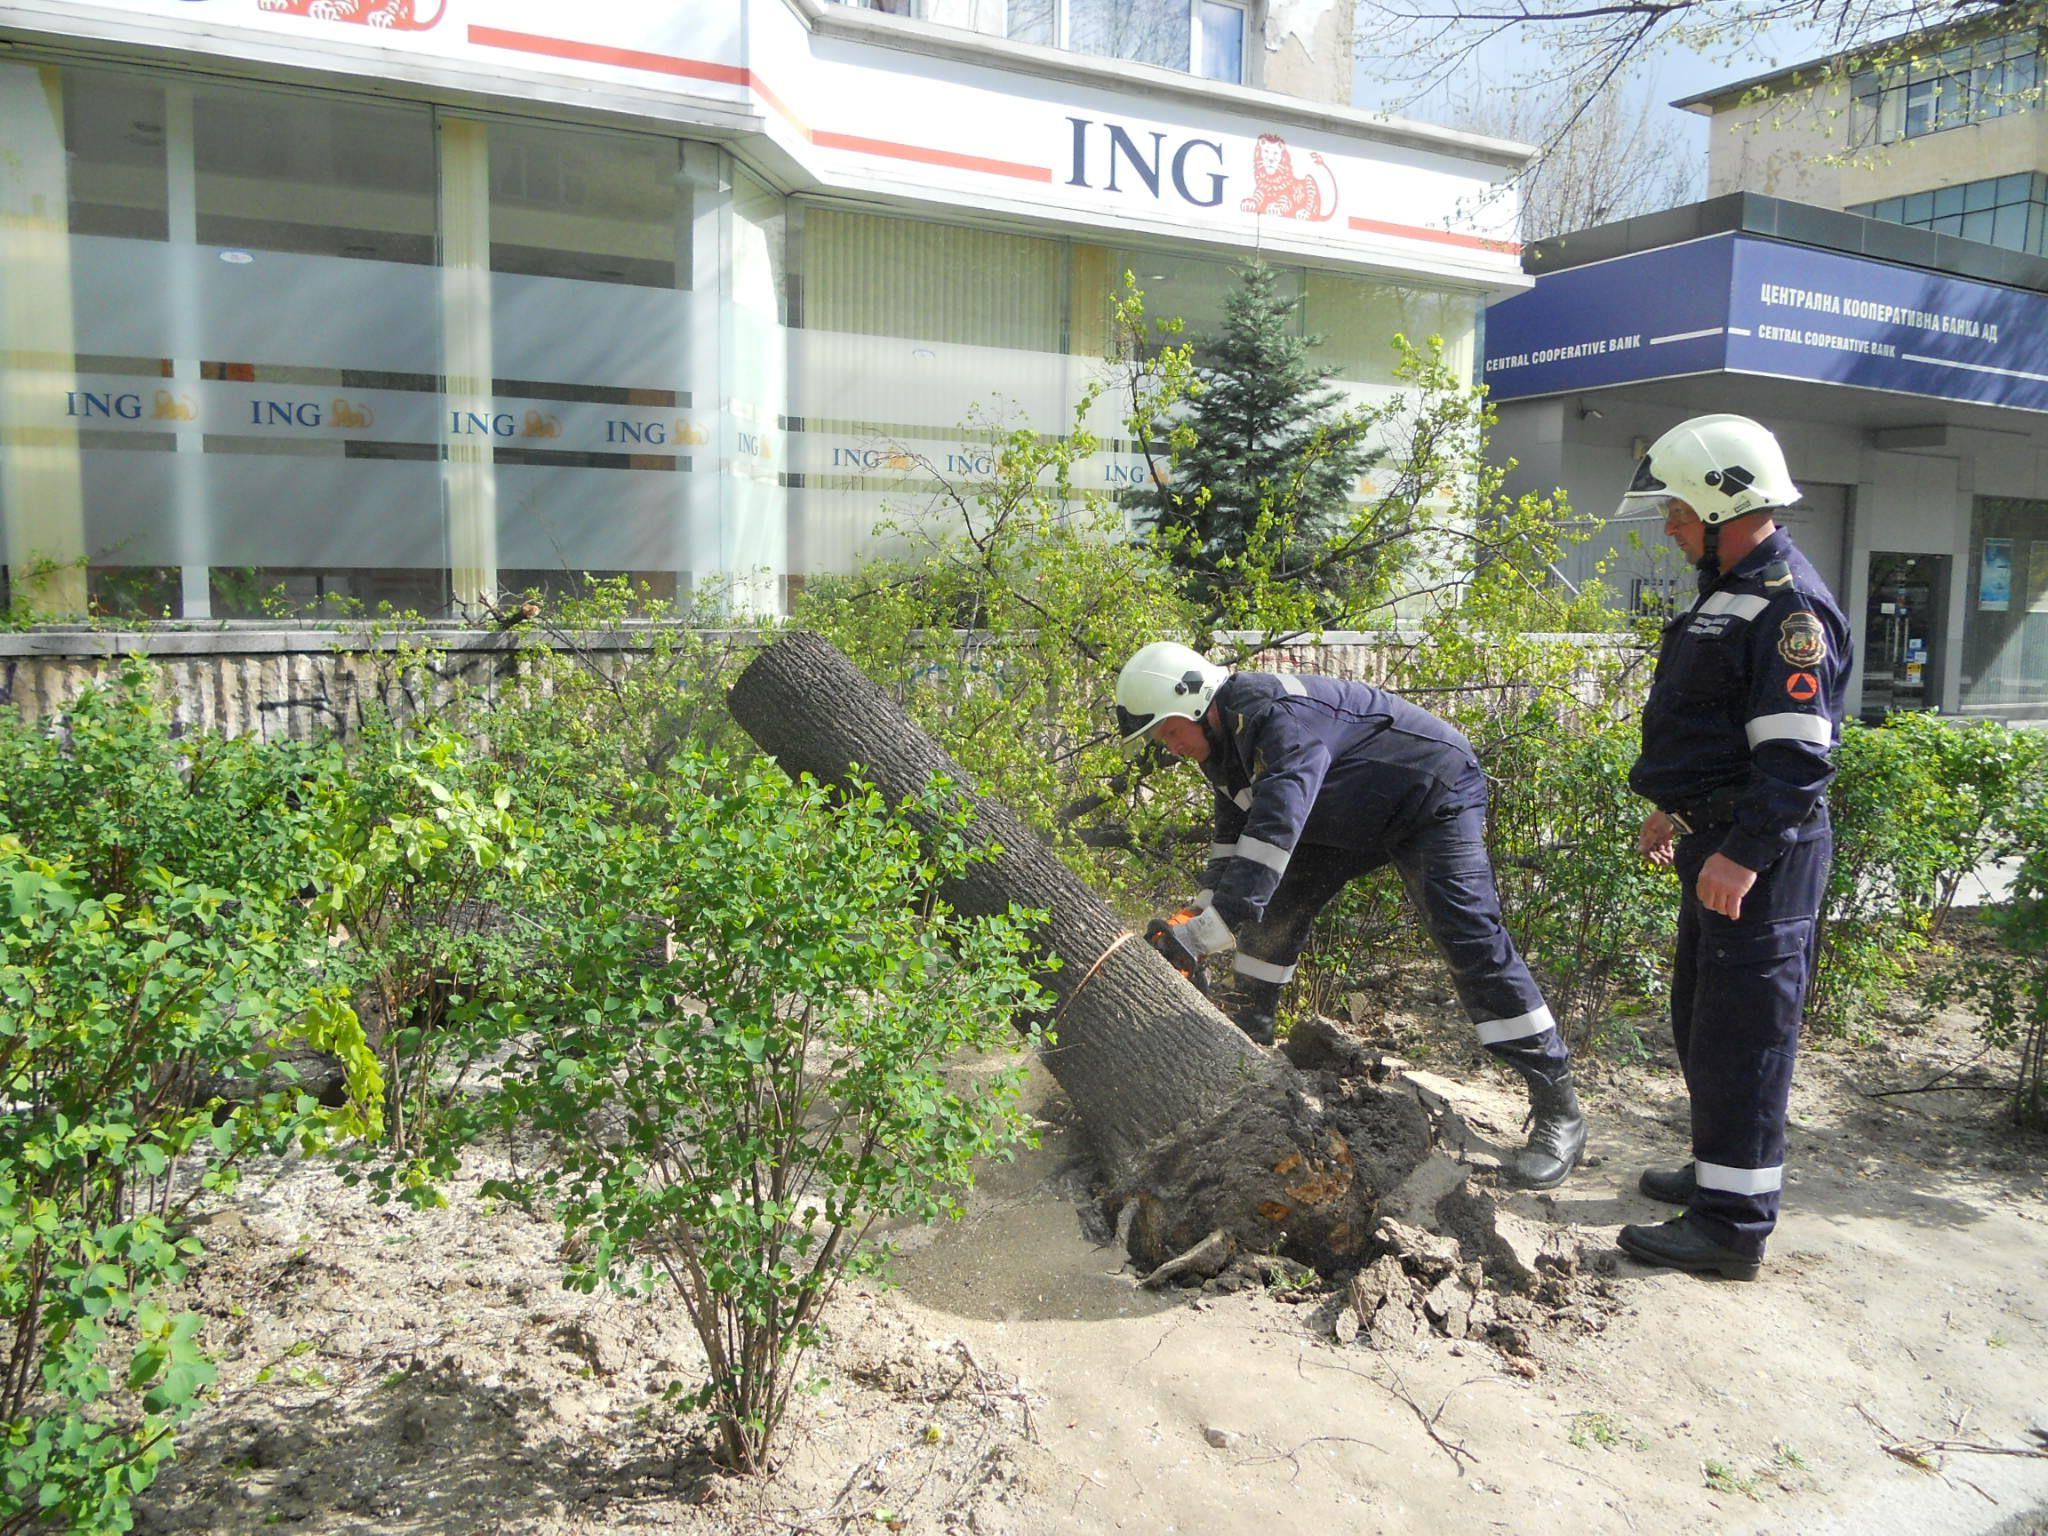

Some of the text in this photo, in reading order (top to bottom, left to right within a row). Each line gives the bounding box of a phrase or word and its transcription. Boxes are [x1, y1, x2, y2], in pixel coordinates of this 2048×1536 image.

[1065, 116, 1229, 207] ING
[1761, 283, 1998, 344] ЦЕНТРАЛНА КООПЕРАТИВНА БАНКА АД
[1486, 334, 1641, 372] CENTRAL COOPERATIVE BANK
[1758, 324, 1896, 358] CENTRAL COOPERATIVE BANK
[66, 391, 142, 419] ING
[251, 400, 321, 427] ING
[450, 411, 515, 437] ING
[606, 420, 666, 445] ING
[738, 432, 759, 457] ING
[833, 447, 880, 468] ING
[947, 454, 991, 475] ING
[1105, 464, 1144, 483] ING
